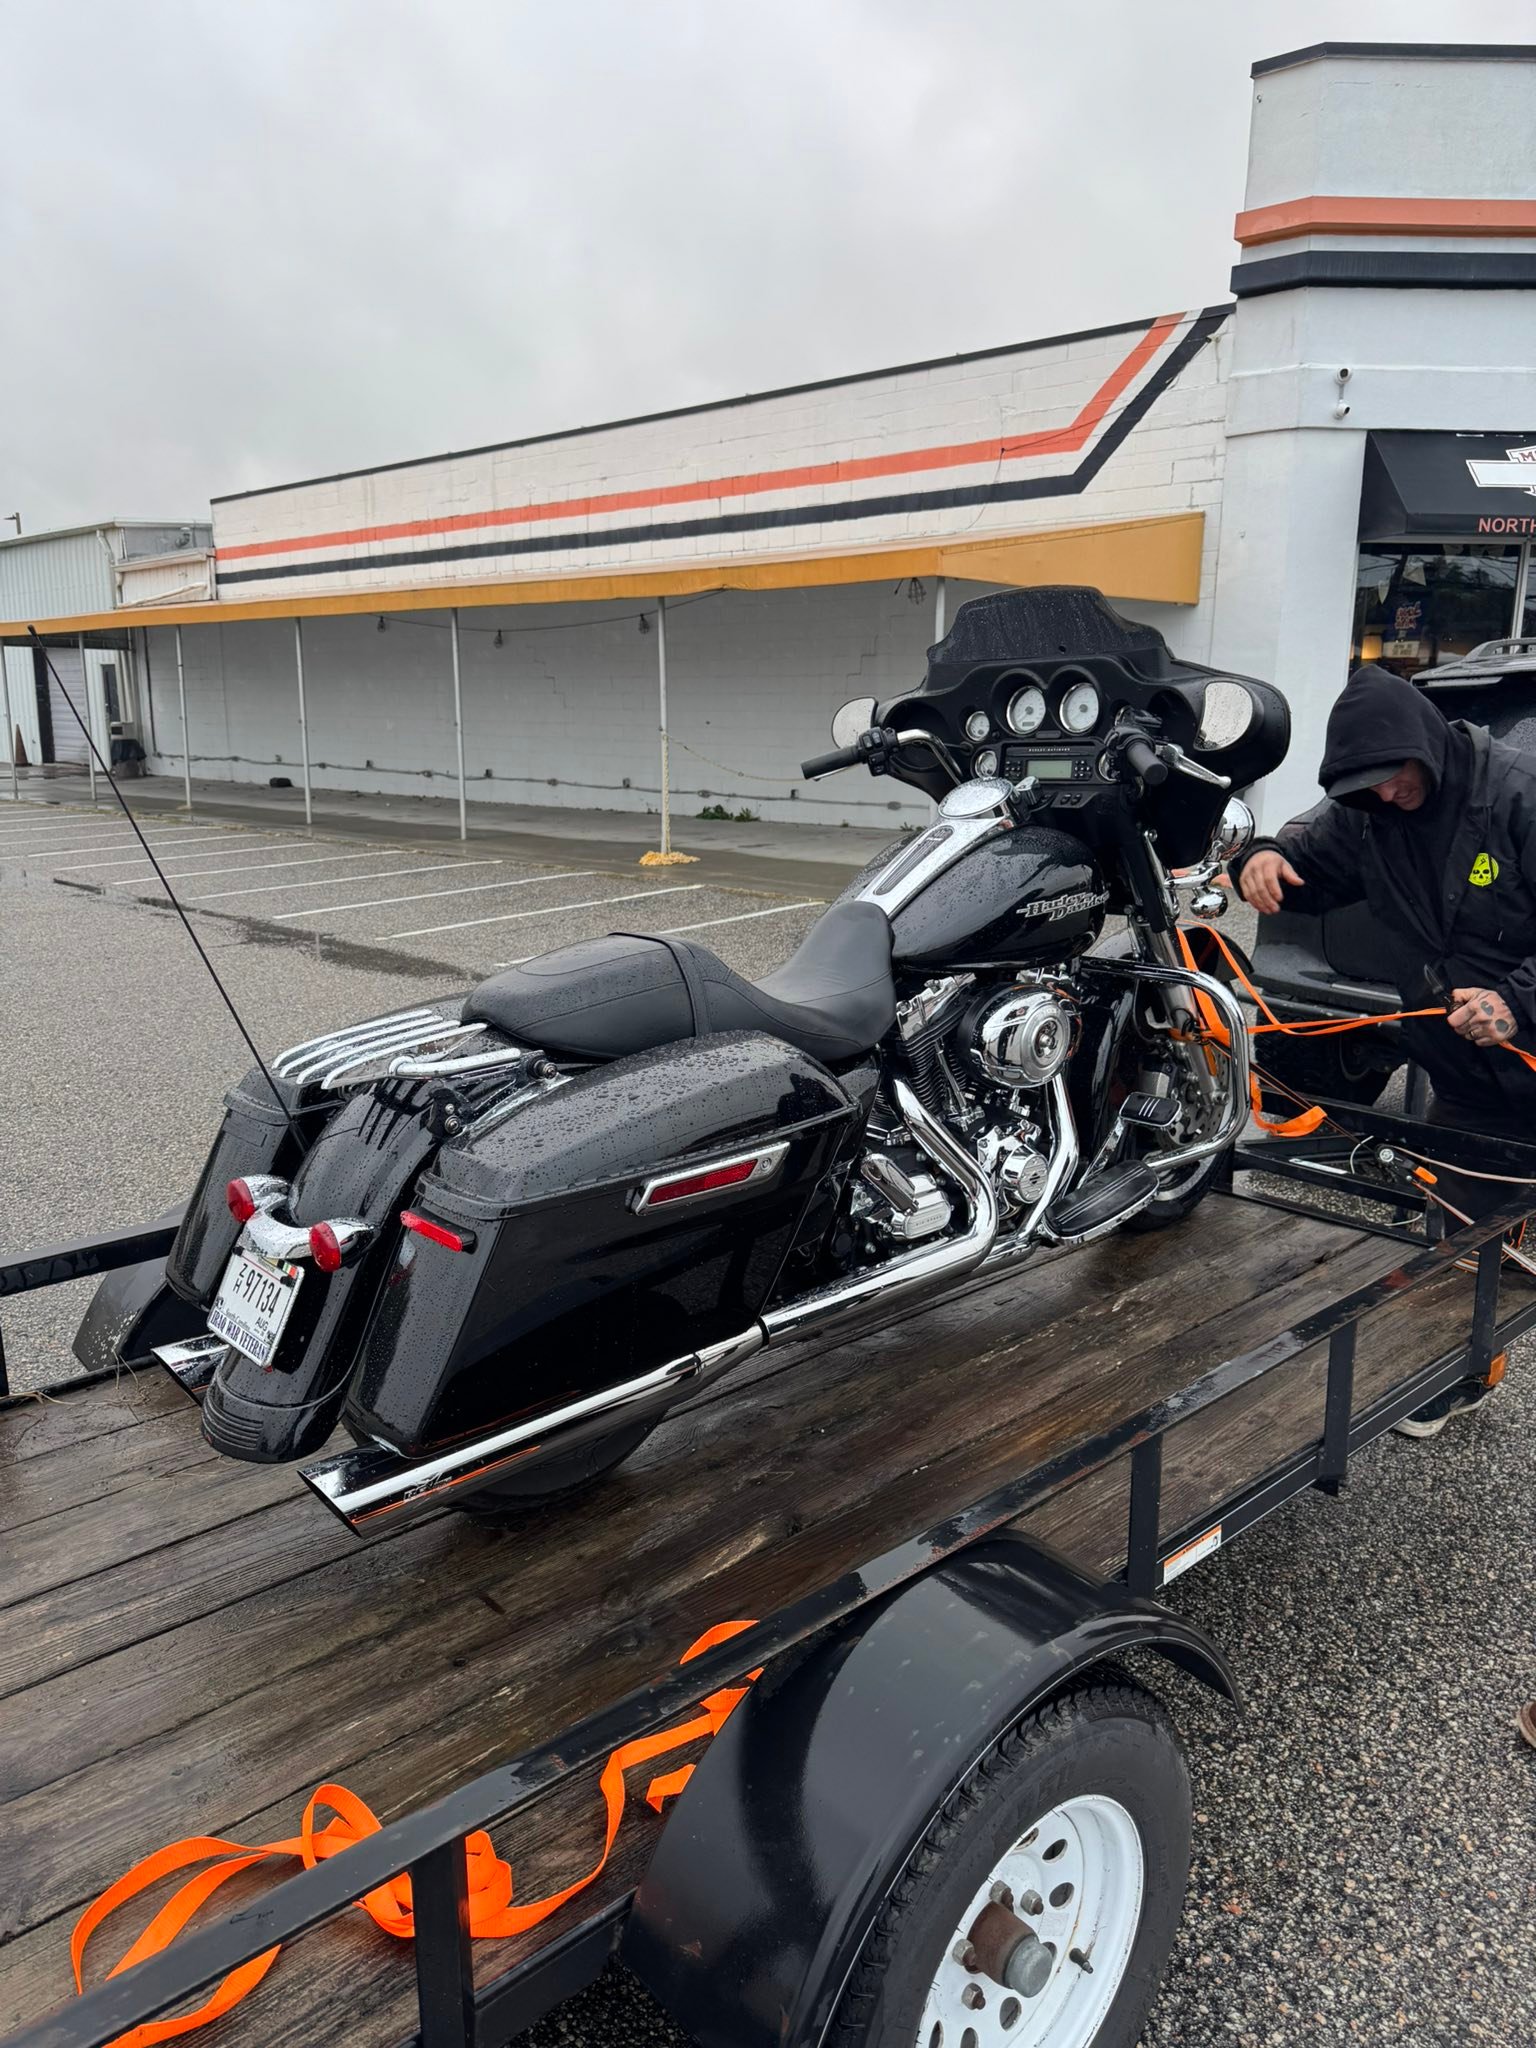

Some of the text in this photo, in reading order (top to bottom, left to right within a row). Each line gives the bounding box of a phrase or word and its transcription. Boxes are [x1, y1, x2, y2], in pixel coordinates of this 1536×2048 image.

[1520, 450, 1536, 462] M
[242, 1269, 282, 1318] 97134
[210, 1310, 227, 1333] IRAQ
[225, 1320, 241, 1342] WAR
[239, 1330, 270, 1360] VETERAN
[255, 1317, 268, 1331] AUG
